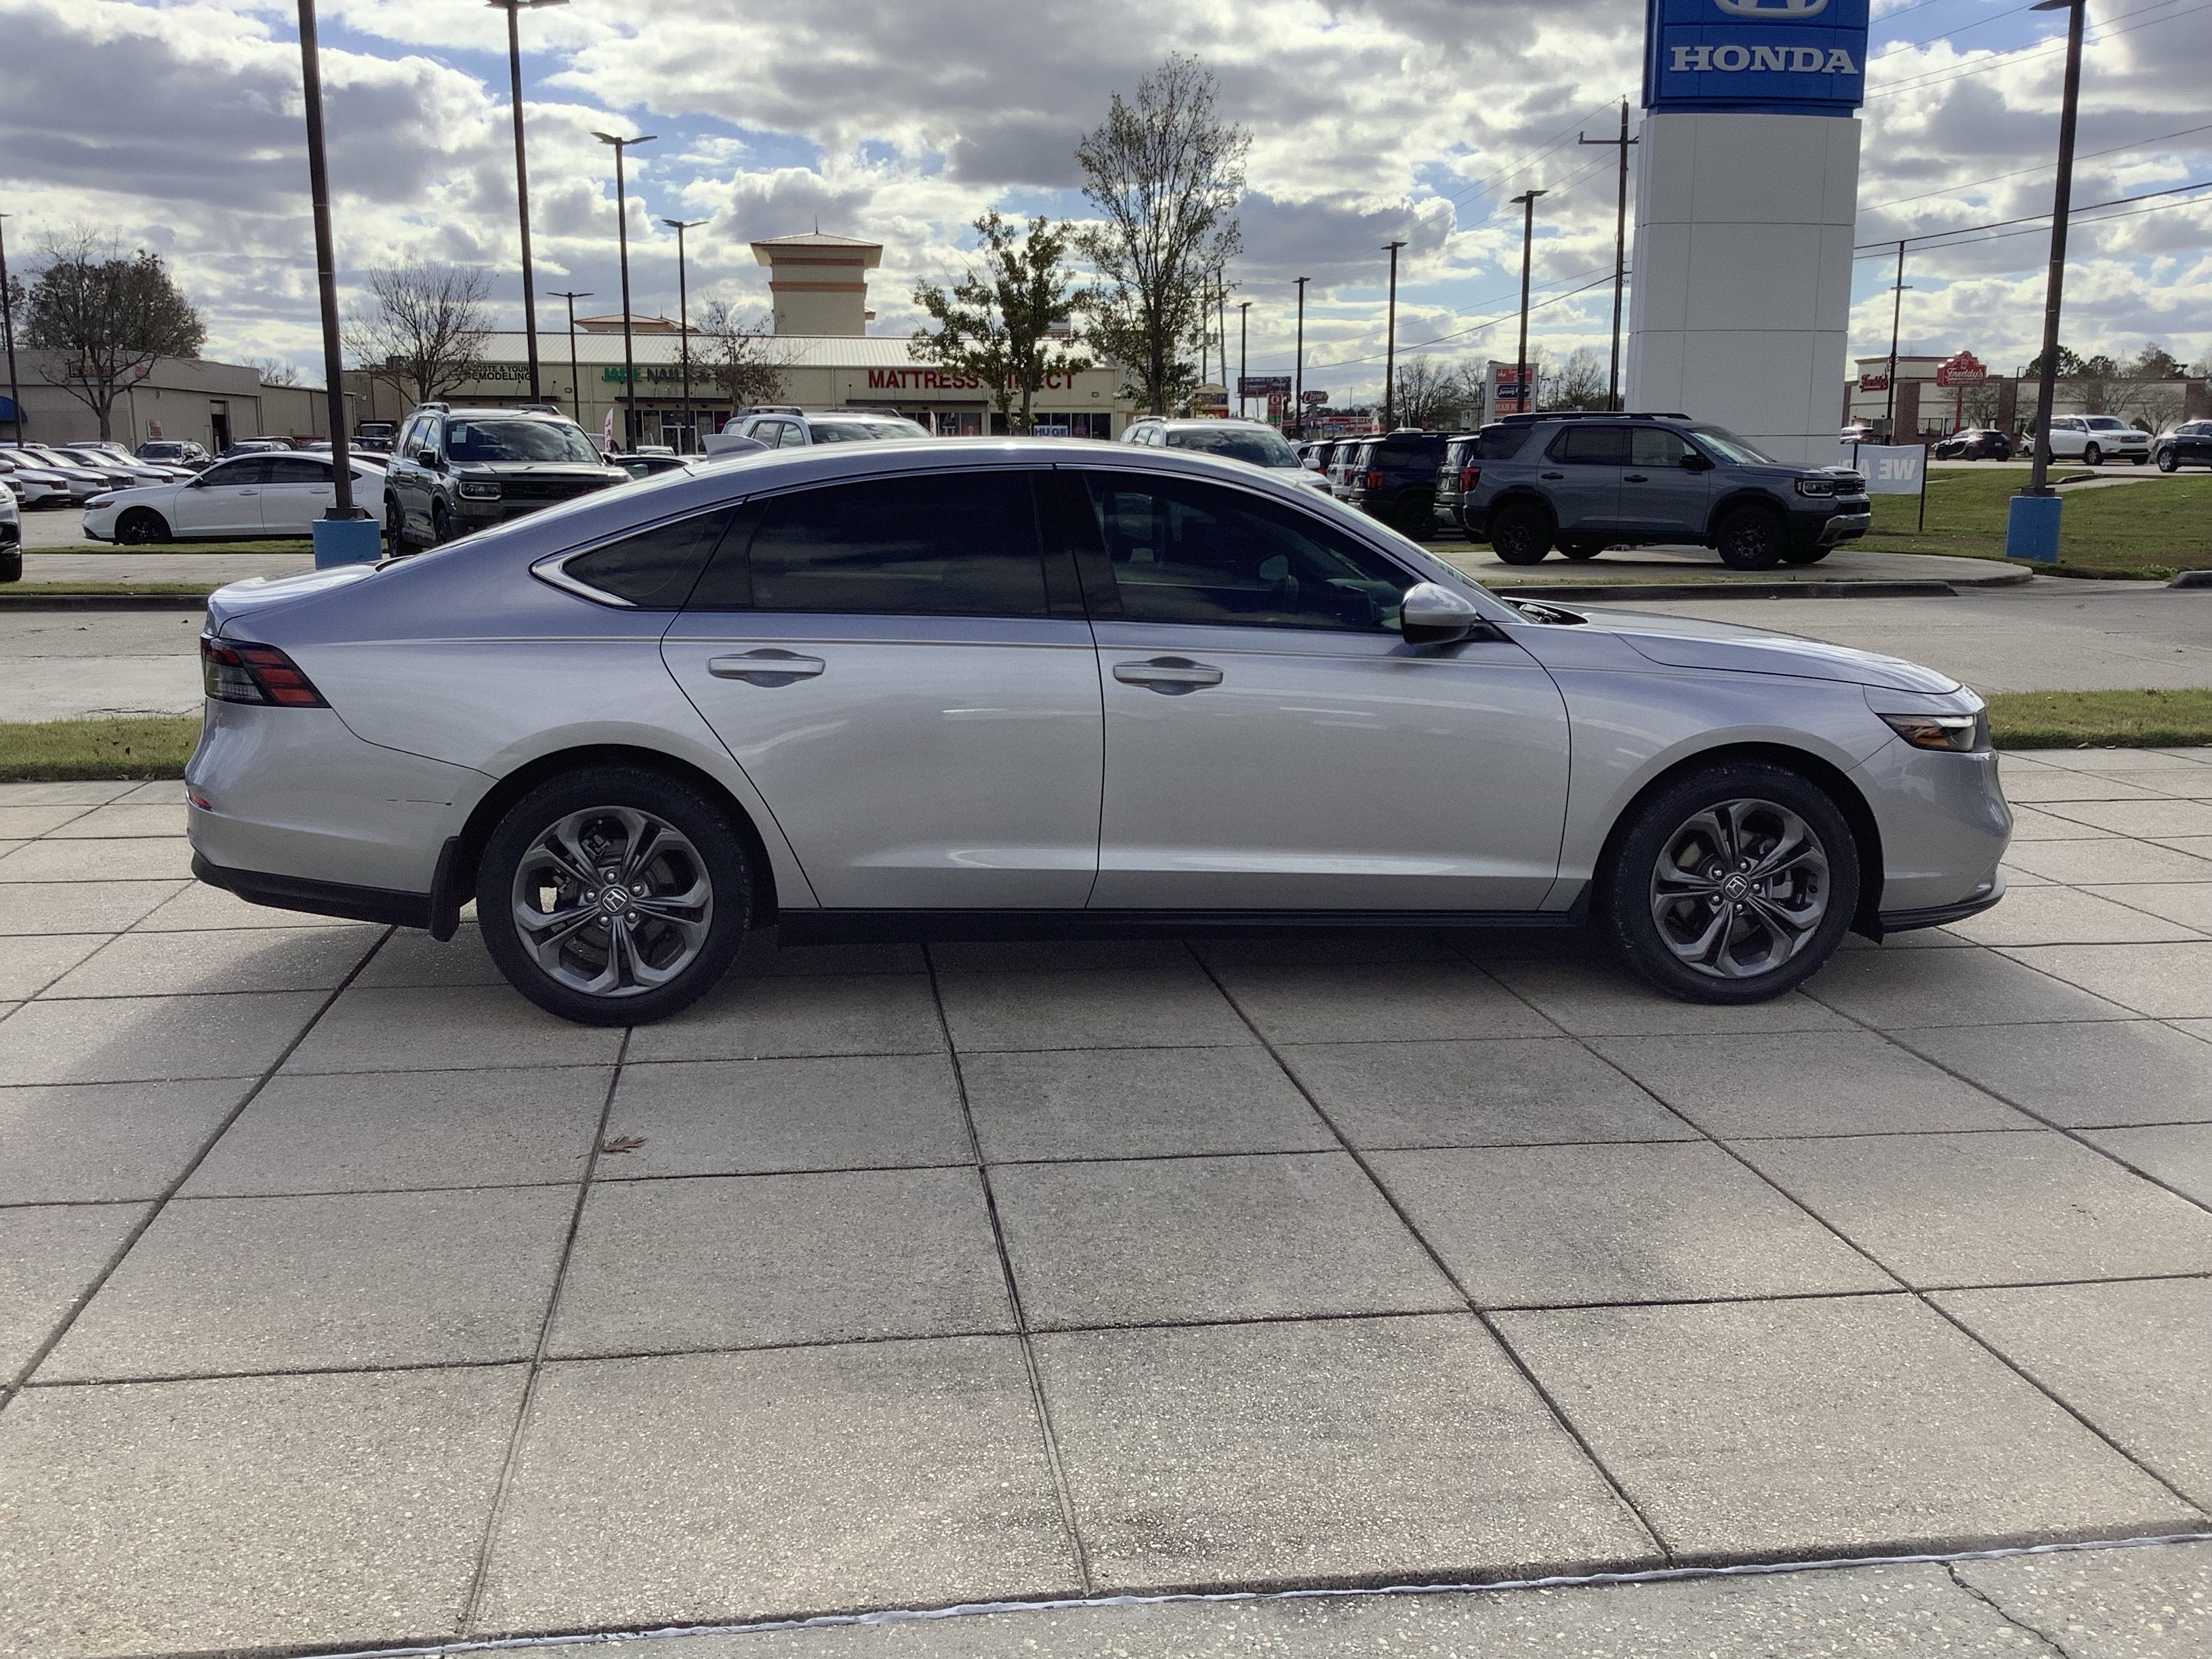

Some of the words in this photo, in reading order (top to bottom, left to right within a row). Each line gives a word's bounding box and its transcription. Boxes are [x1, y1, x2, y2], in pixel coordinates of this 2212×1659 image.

[1669, 45, 1859, 75] HONDA
[868, 369, 979, 389] MATTRESS
[1944, 367, 1984, 380] Freddy's
[1035, 428, 1067, 436] HUGE
